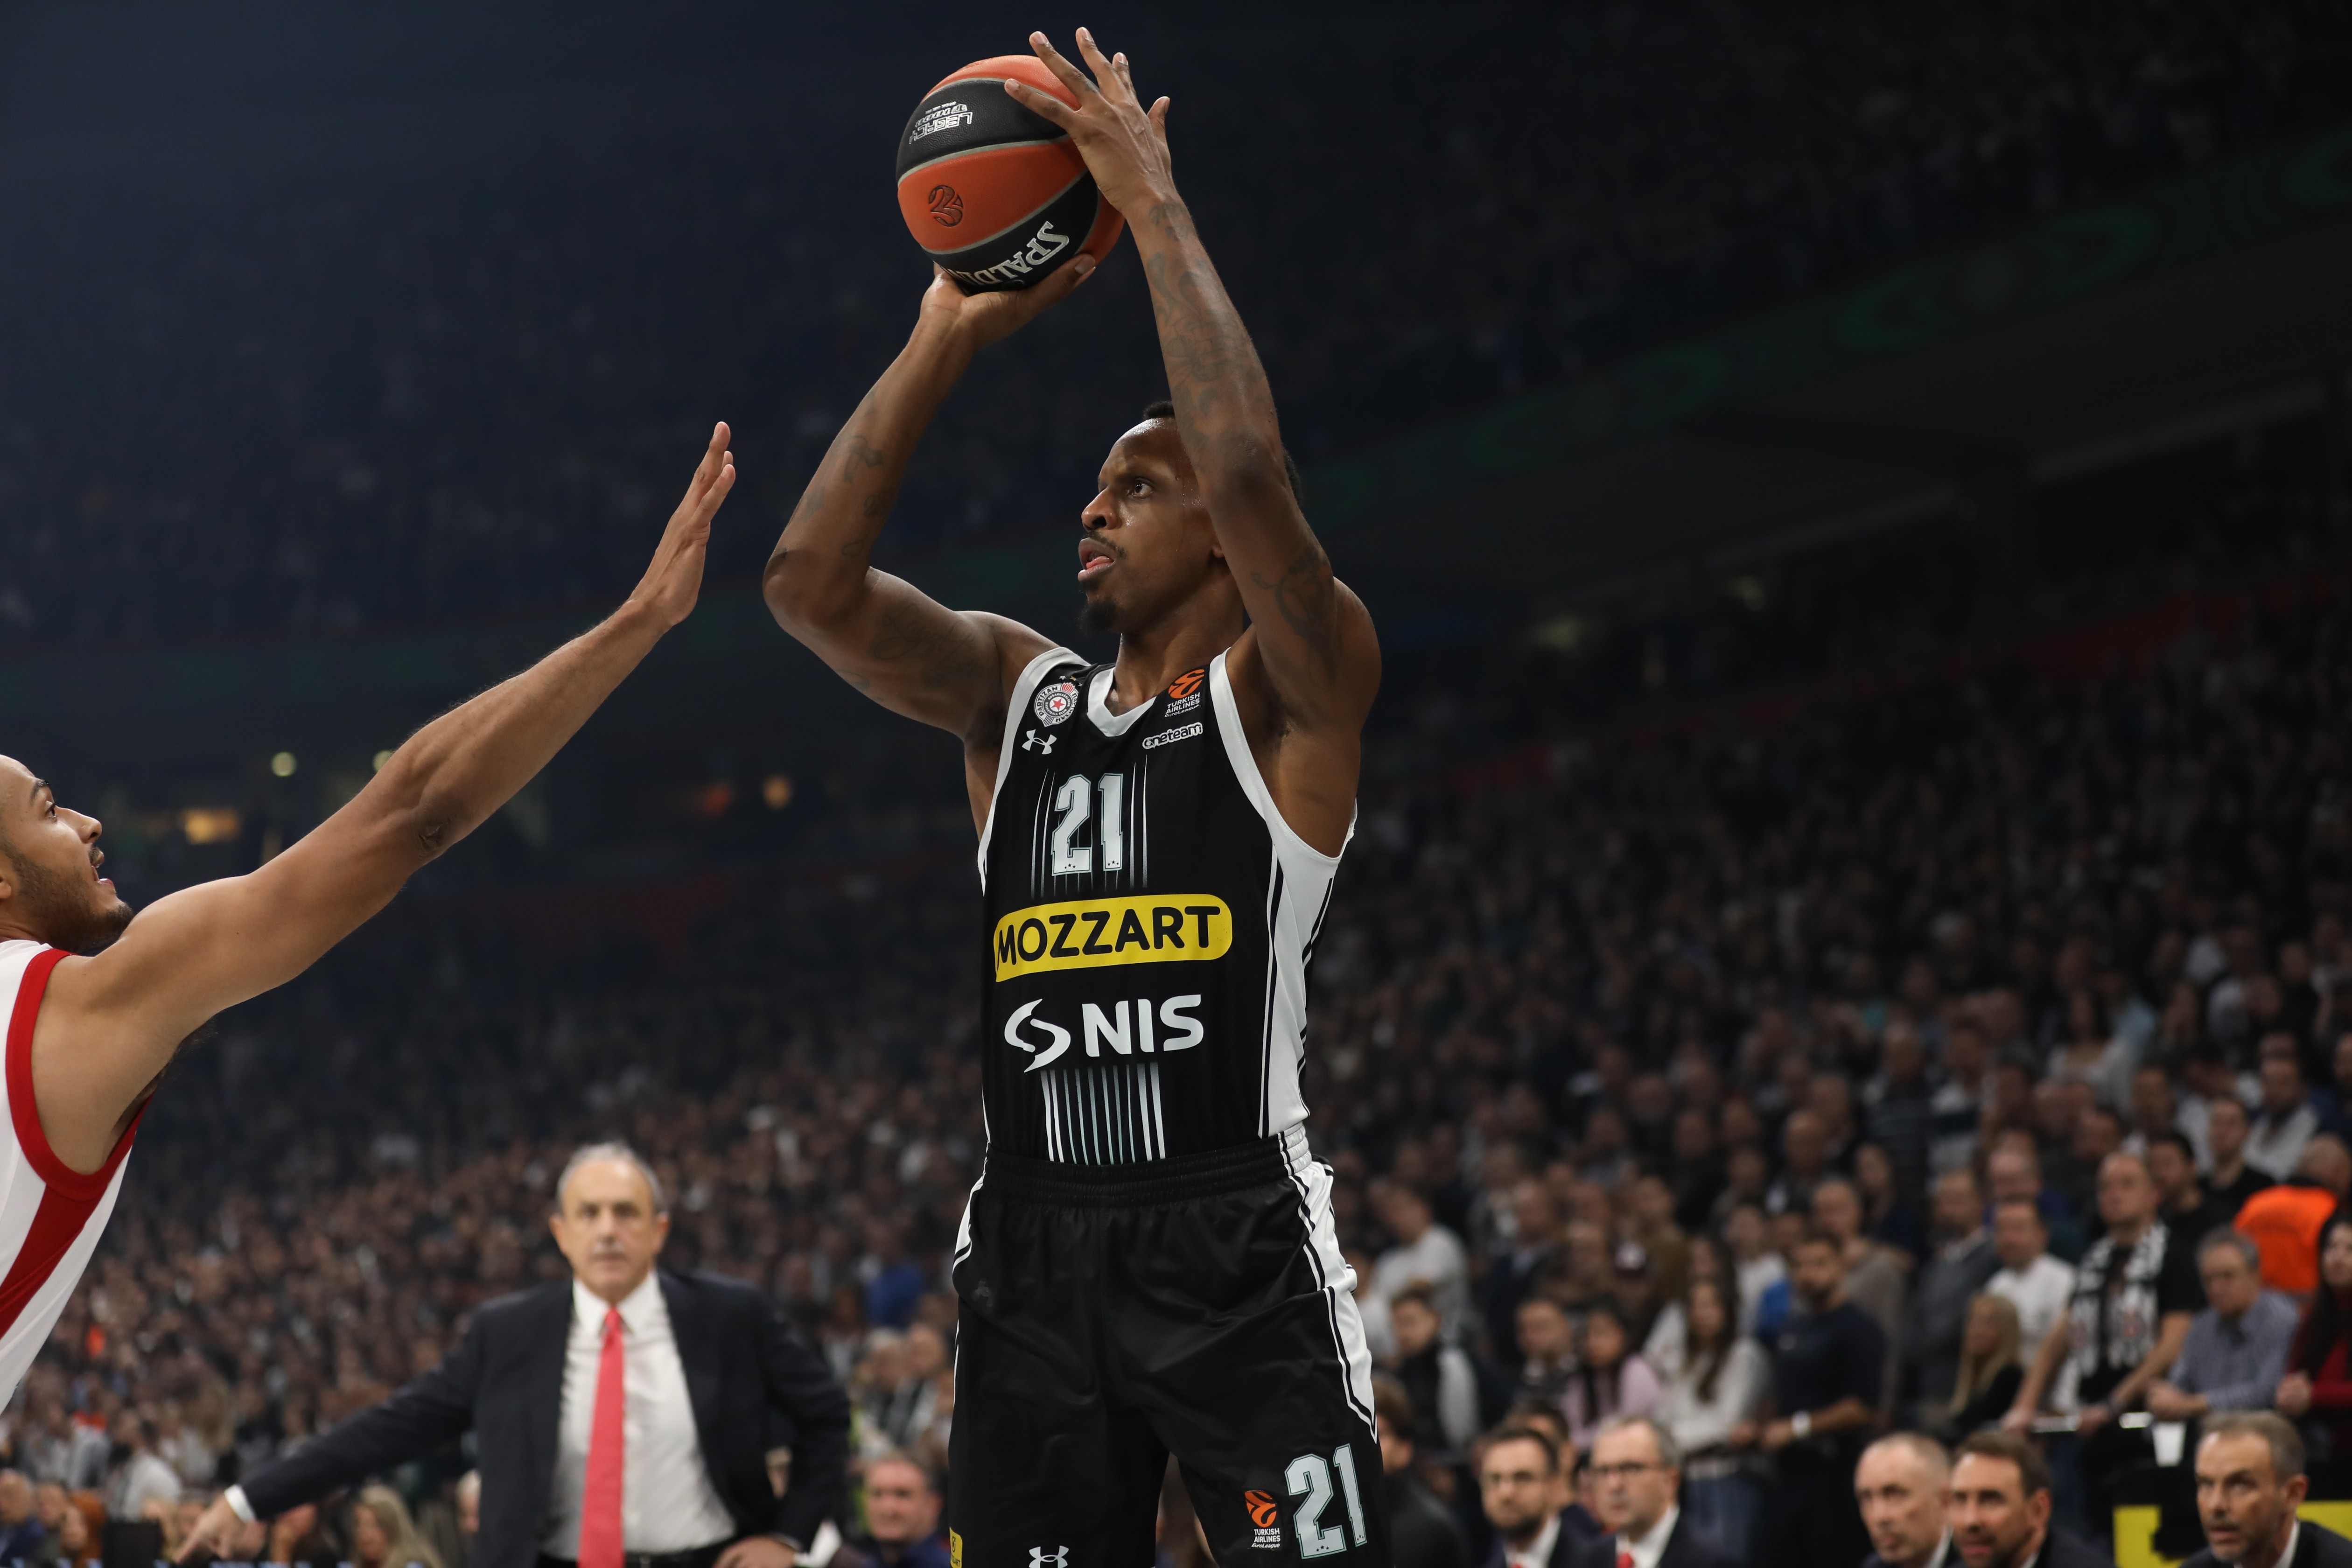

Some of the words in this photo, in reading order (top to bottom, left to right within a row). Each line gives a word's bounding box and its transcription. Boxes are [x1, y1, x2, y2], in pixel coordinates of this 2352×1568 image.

[909, 112, 973, 145] LEGACY
[1037, 686, 1057, 716] PARTIZAN
[1045, 701, 1058, 715] BASKETBALL
[1166, 698, 1200, 714] AIRLINES
[1167, 692, 1200, 709] TURKISH
[1142, 722, 1203, 749] oneteam
[1051, 773, 1123, 876] 21
[997, 906, 1221, 971] MOZZART
[1082, 994, 1204, 1057] NIS
[1284, 1443, 1367, 1560] 21
[1253, 1527, 1280, 1536] TURKISH
